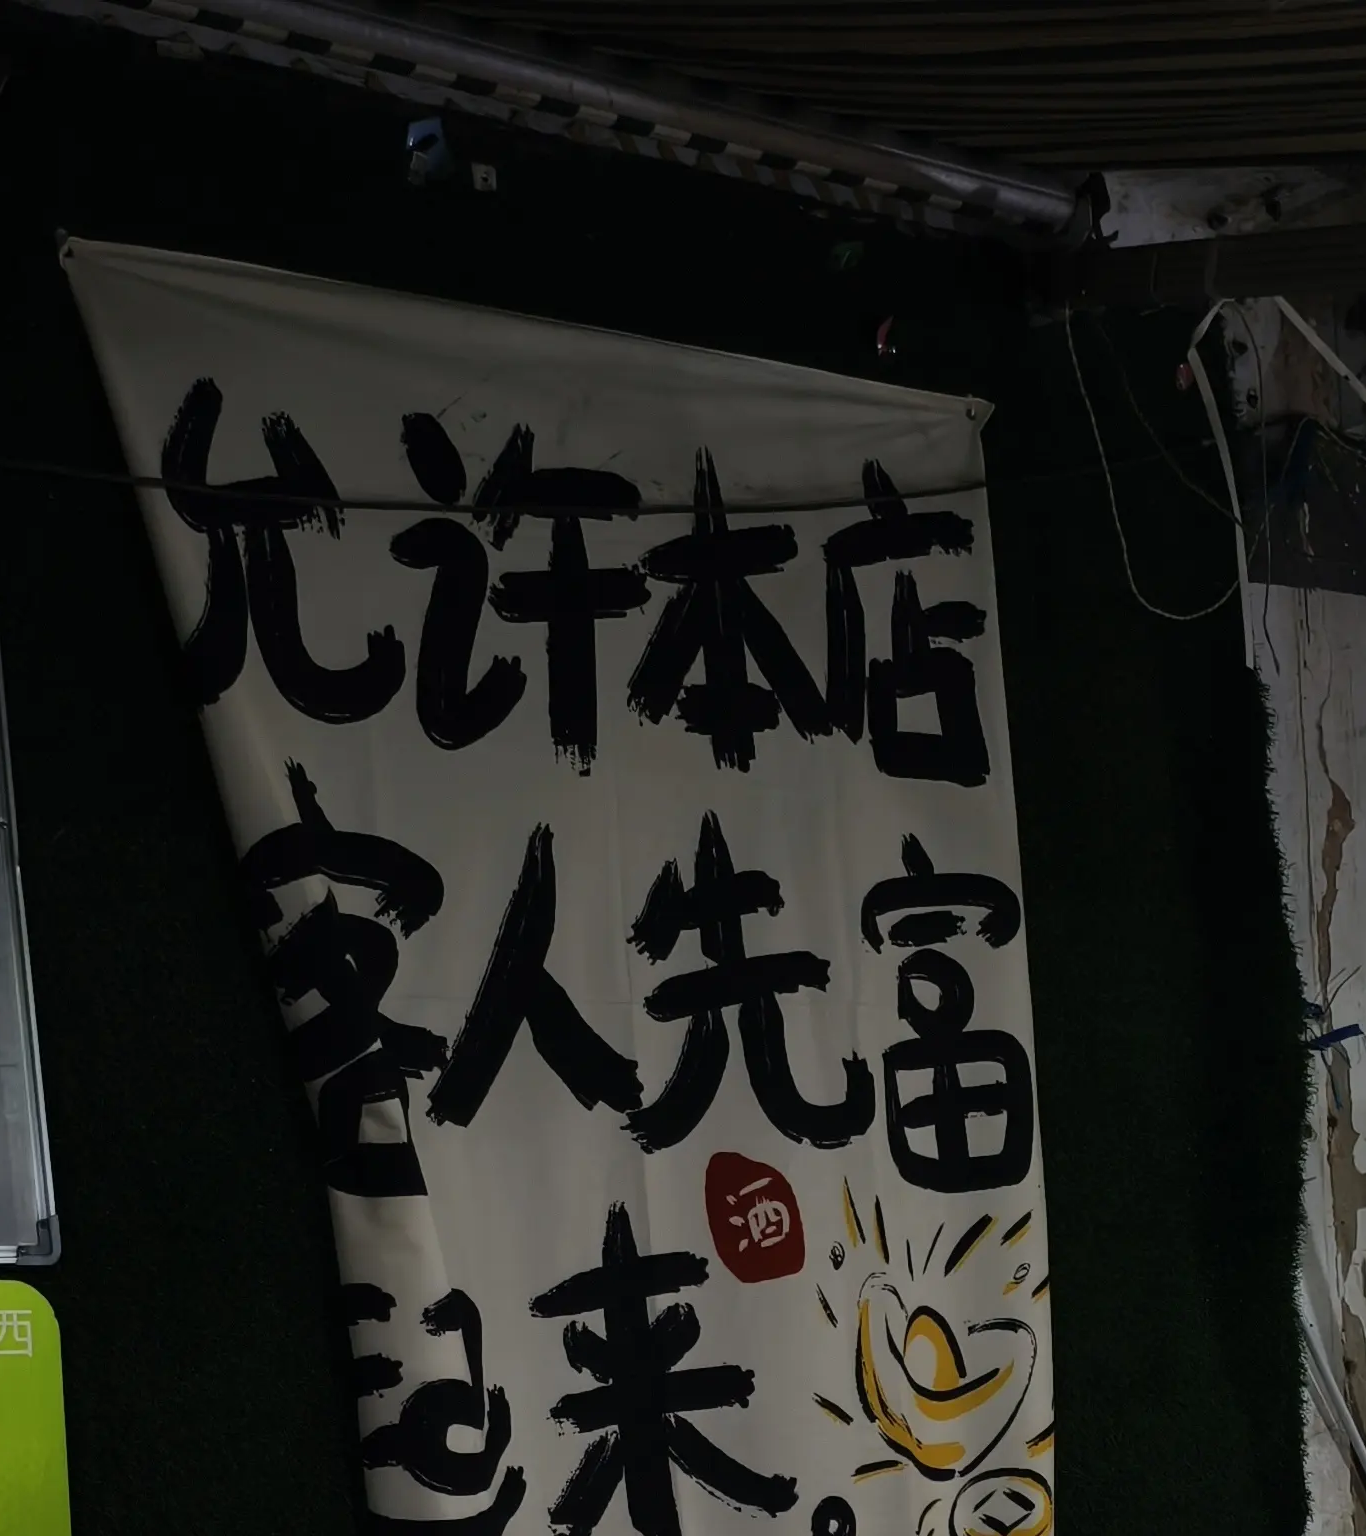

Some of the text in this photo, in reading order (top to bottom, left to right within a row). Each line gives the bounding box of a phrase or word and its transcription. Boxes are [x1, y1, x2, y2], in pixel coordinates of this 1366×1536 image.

[162, 376, 990, 786] 允许本店
[238, 758, 1033, 1197] 客人先富
